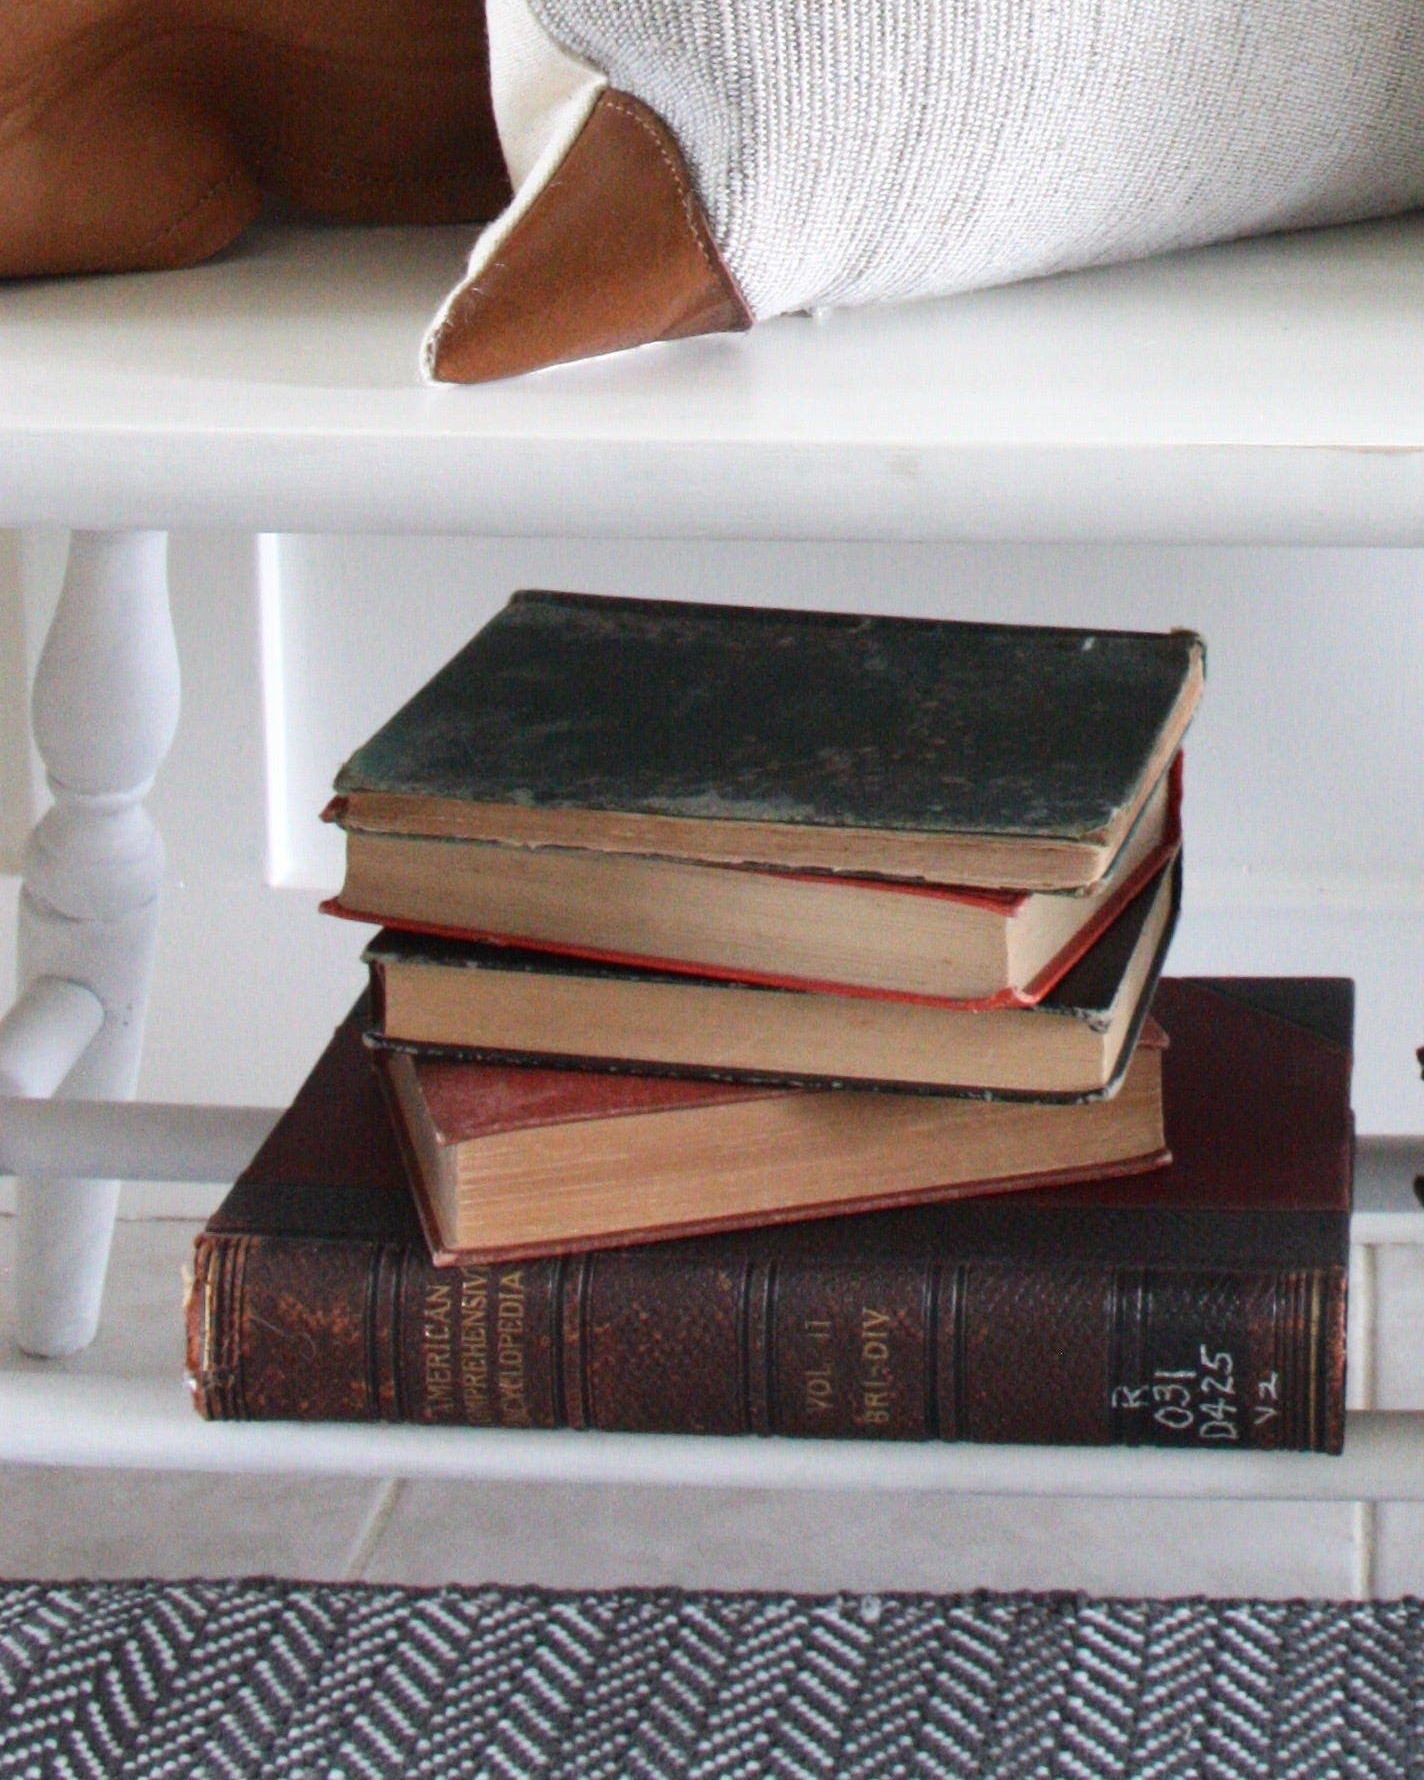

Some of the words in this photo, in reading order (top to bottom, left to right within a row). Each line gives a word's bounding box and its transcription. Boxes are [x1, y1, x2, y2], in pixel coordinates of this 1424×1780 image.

[424, 1284, 453, 1419] AMERICAN
[1110, 1384, 1150, 1410] R
[1152, 1369, 1197, 1429] 031
[1198, 1344, 1239, 1441] D425
